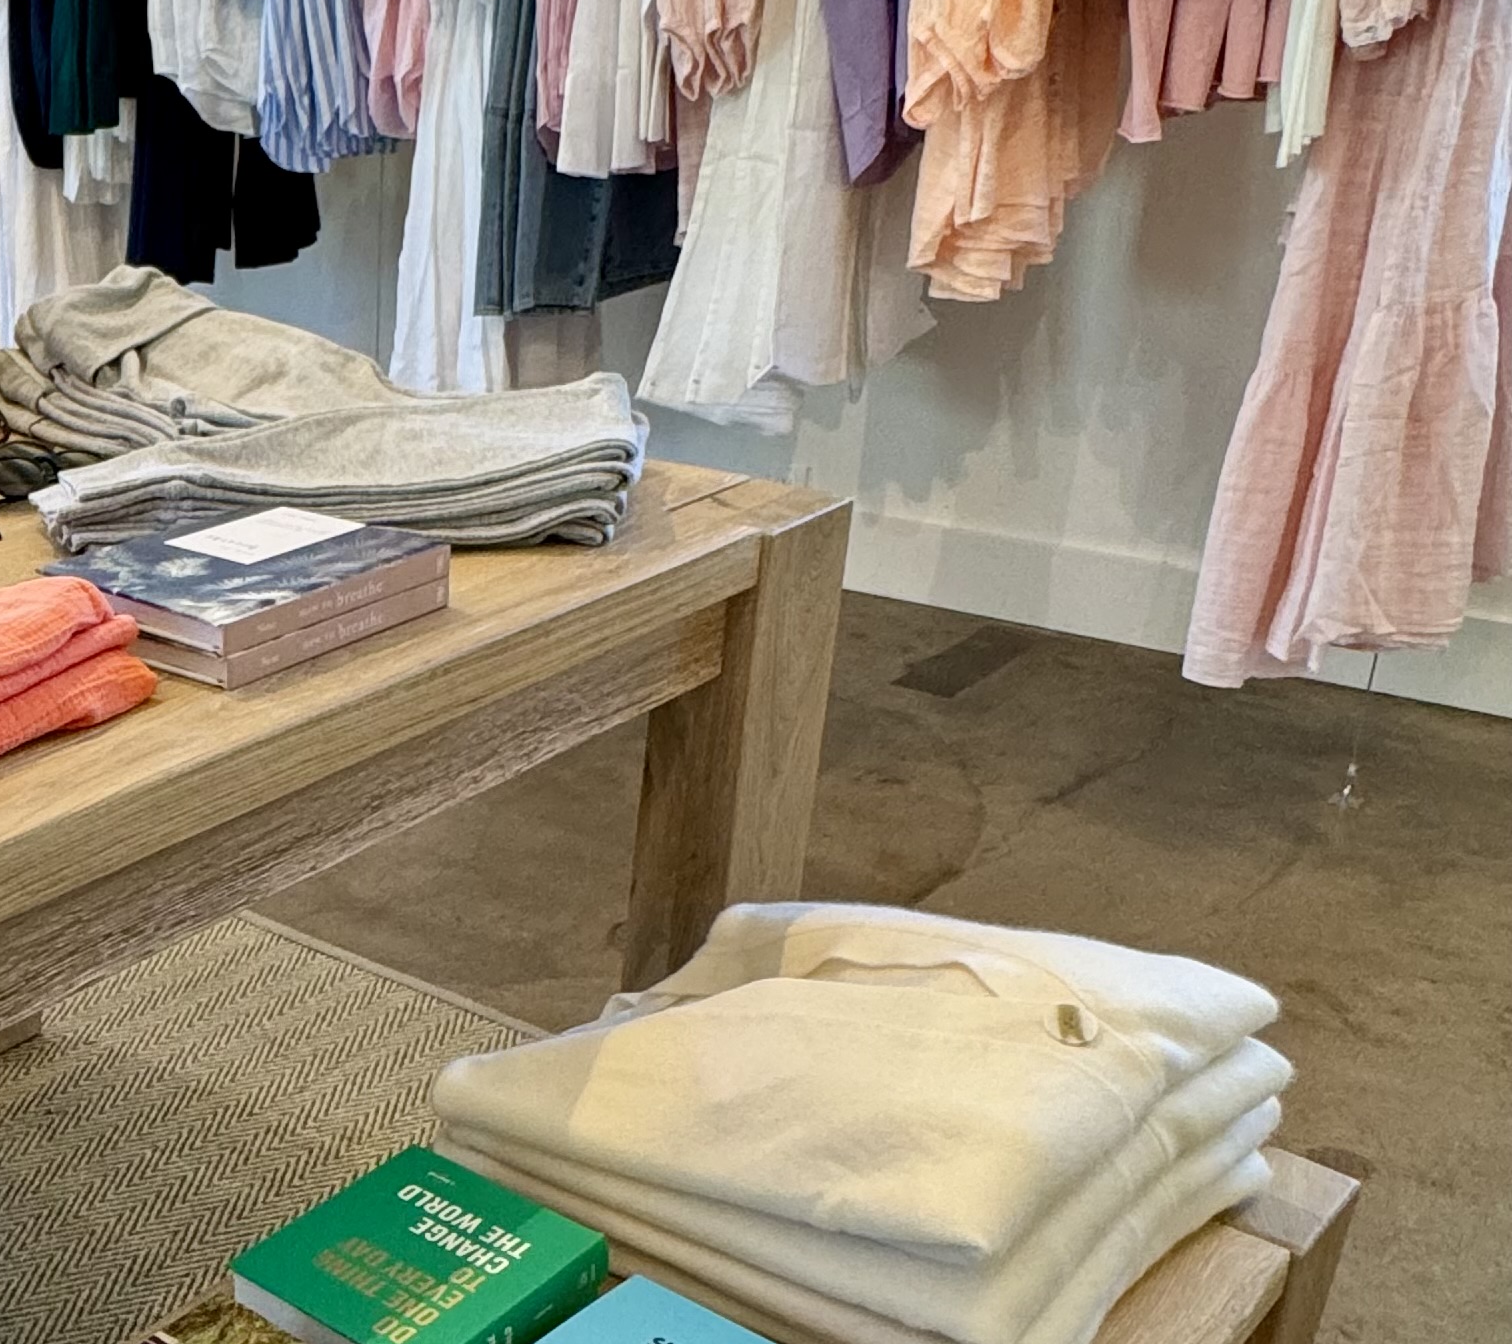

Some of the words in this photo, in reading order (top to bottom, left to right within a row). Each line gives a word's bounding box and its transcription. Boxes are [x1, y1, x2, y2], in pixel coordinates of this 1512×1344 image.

[336, 579, 384, 605] breathe
[396, 1183, 483, 1232] WORLD
[339, 1235, 390, 1266] DAY
[408, 1216, 511, 1276] CHANGE
[478, 1224, 532, 1261] THE
[311, 1247, 386, 1299] THING
[385, 1262, 467, 1312] EVERY
[448, 1266, 487, 1295] TO
[383, 1289, 441, 1327] ONE
